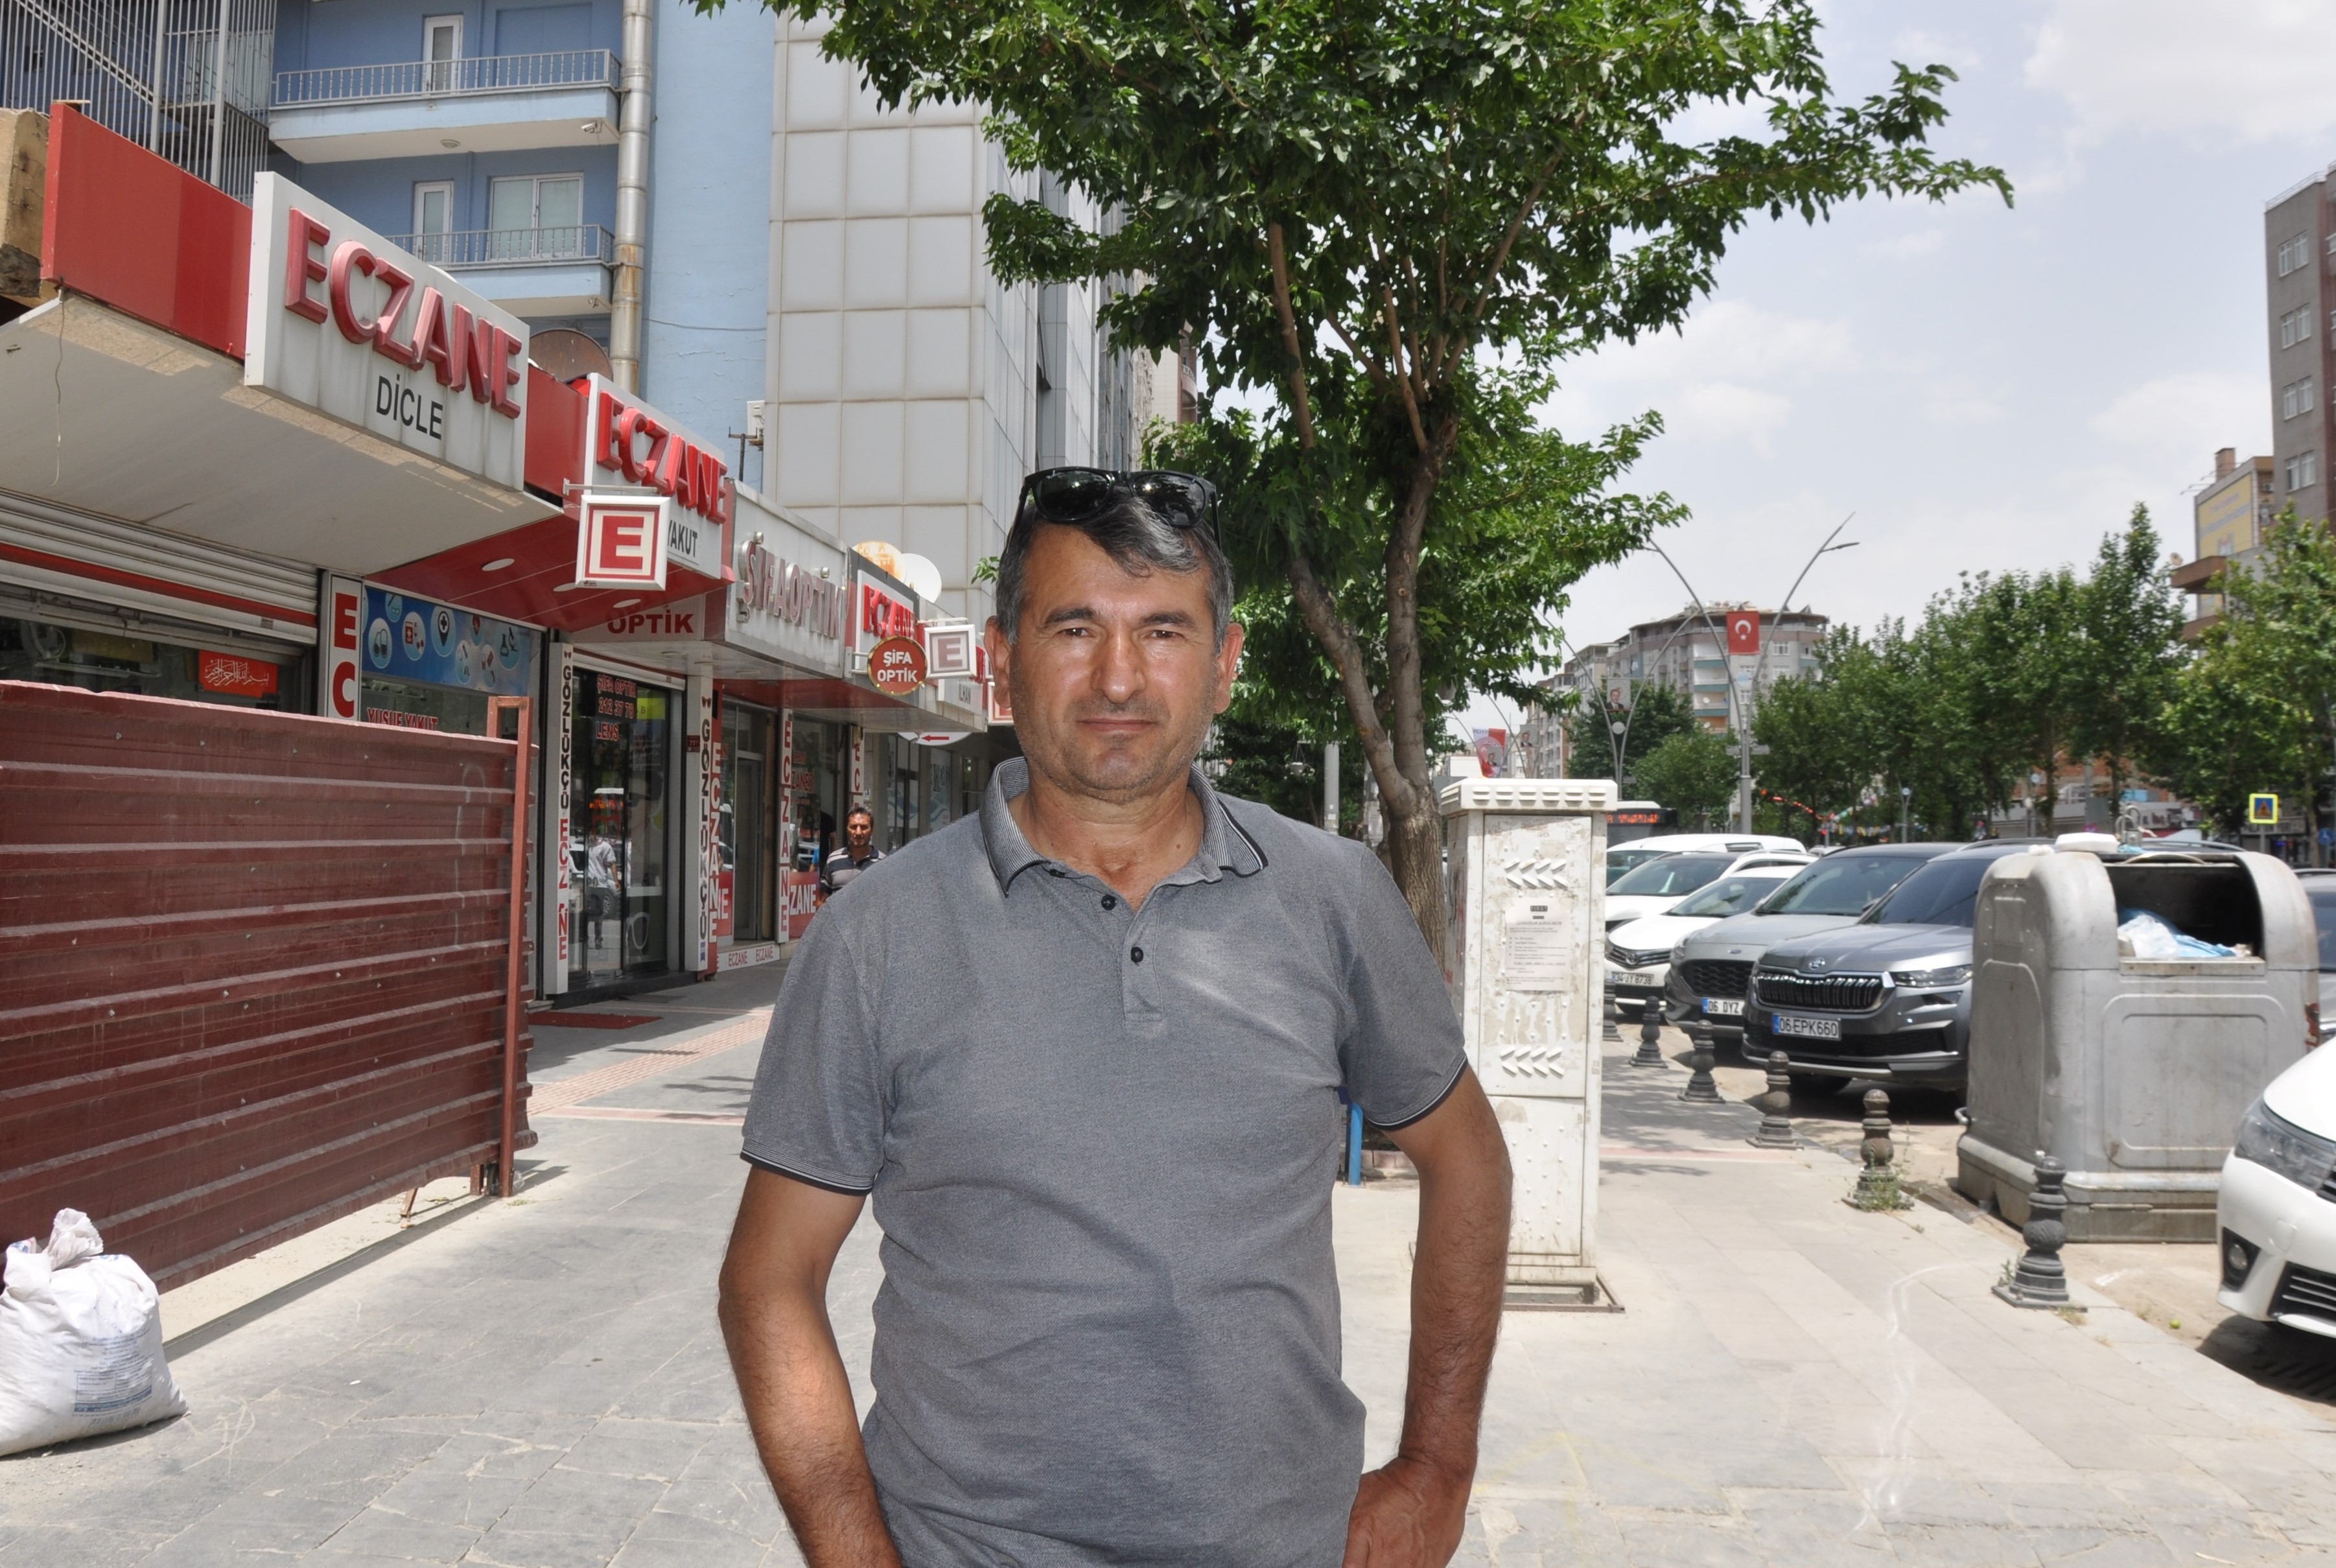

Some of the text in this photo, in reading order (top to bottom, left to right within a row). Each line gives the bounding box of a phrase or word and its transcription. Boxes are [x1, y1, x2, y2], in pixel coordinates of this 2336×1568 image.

[285, 207, 522, 420] ECZANE
[377, 373, 443, 441] DİCLE
[597, 390, 728, 524] ECZANE
[600, 515, 646, 570] E
[607, 609, 694, 634] OPTİK
[877, 667, 918, 683] OPTİK
[882, 649, 913, 667] ŞİFA
[938, 637, 963, 669] E
[561, 665, 572, 810] GÖZLÜKÇÜ
[596, 721, 620, 742] LENS
[709, 742, 721, 943] ECZANE
[780, 720, 791, 932] ECZANE
[729, 950, 748, 967] ECZANE
[756, 946, 774, 963] ECZANE
